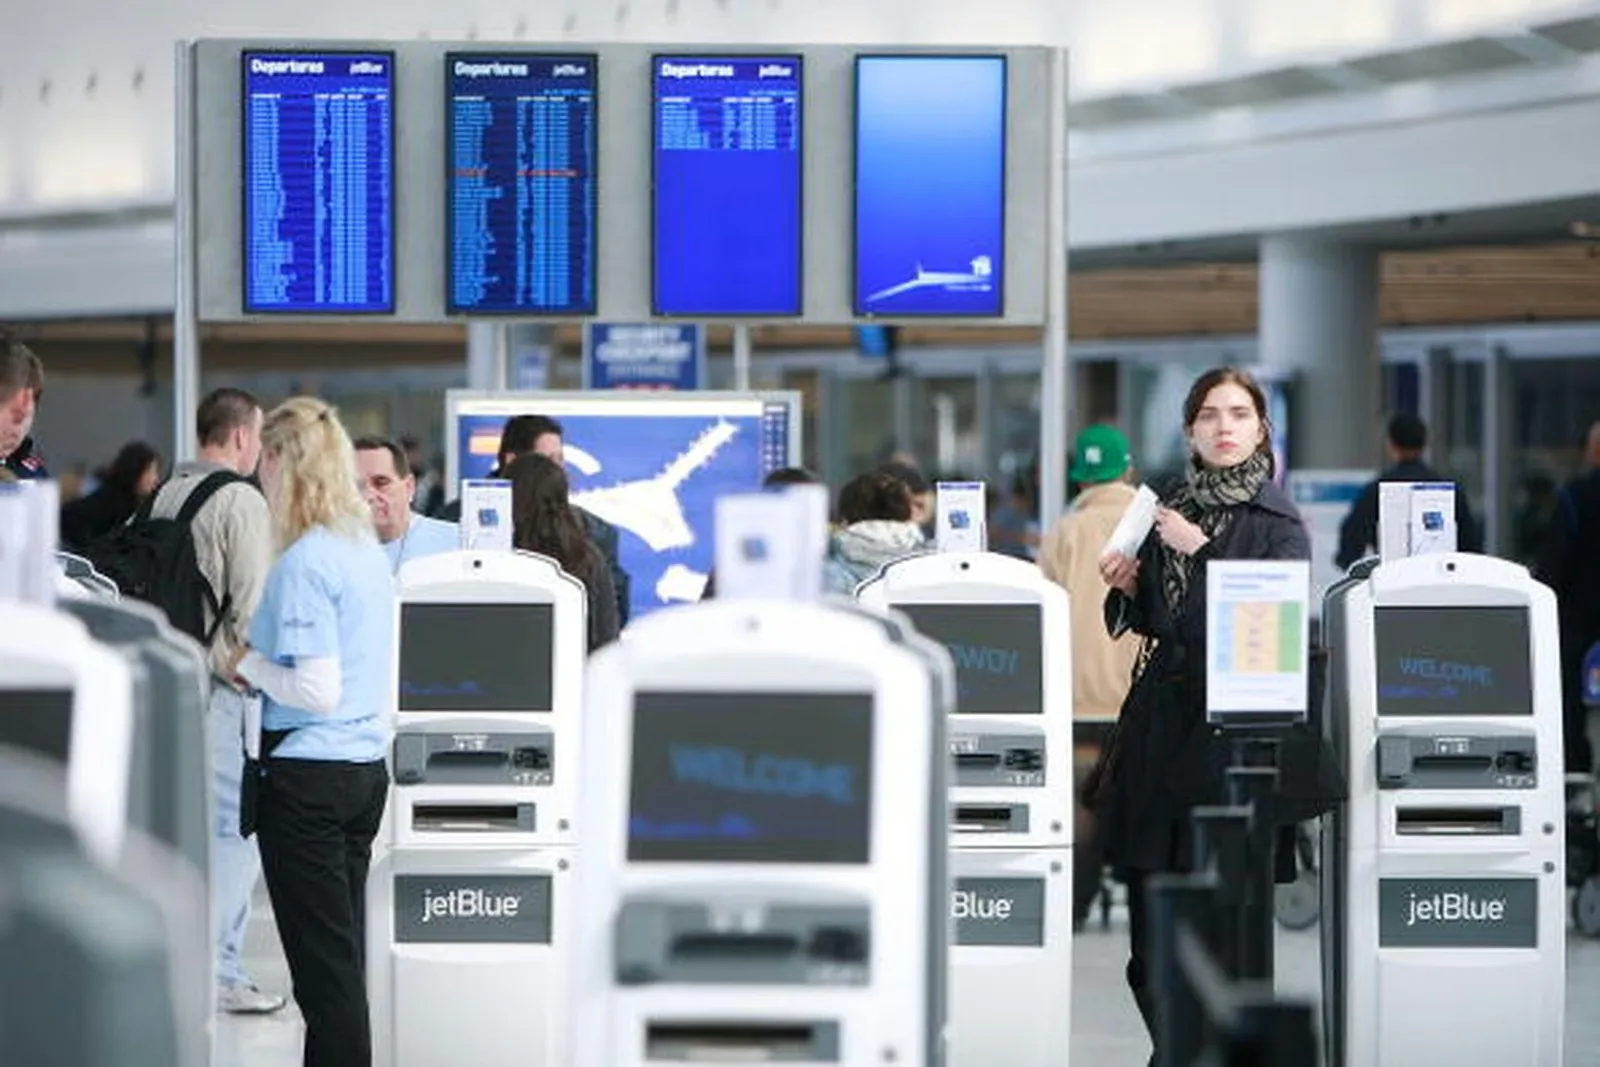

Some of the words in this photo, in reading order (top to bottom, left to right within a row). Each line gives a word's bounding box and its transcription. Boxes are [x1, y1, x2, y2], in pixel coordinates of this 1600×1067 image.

[251, 59, 324, 76] Departures
[454, 61, 528, 77] Departures
[661, 63, 734, 79] Departures
[1399, 656, 1494, 688] WELCOME
[421, 888, 520, 922] jetBlue
[950, 890, 1013, 919] Blue
[1407, 892, 1506, 926] jetBlue
